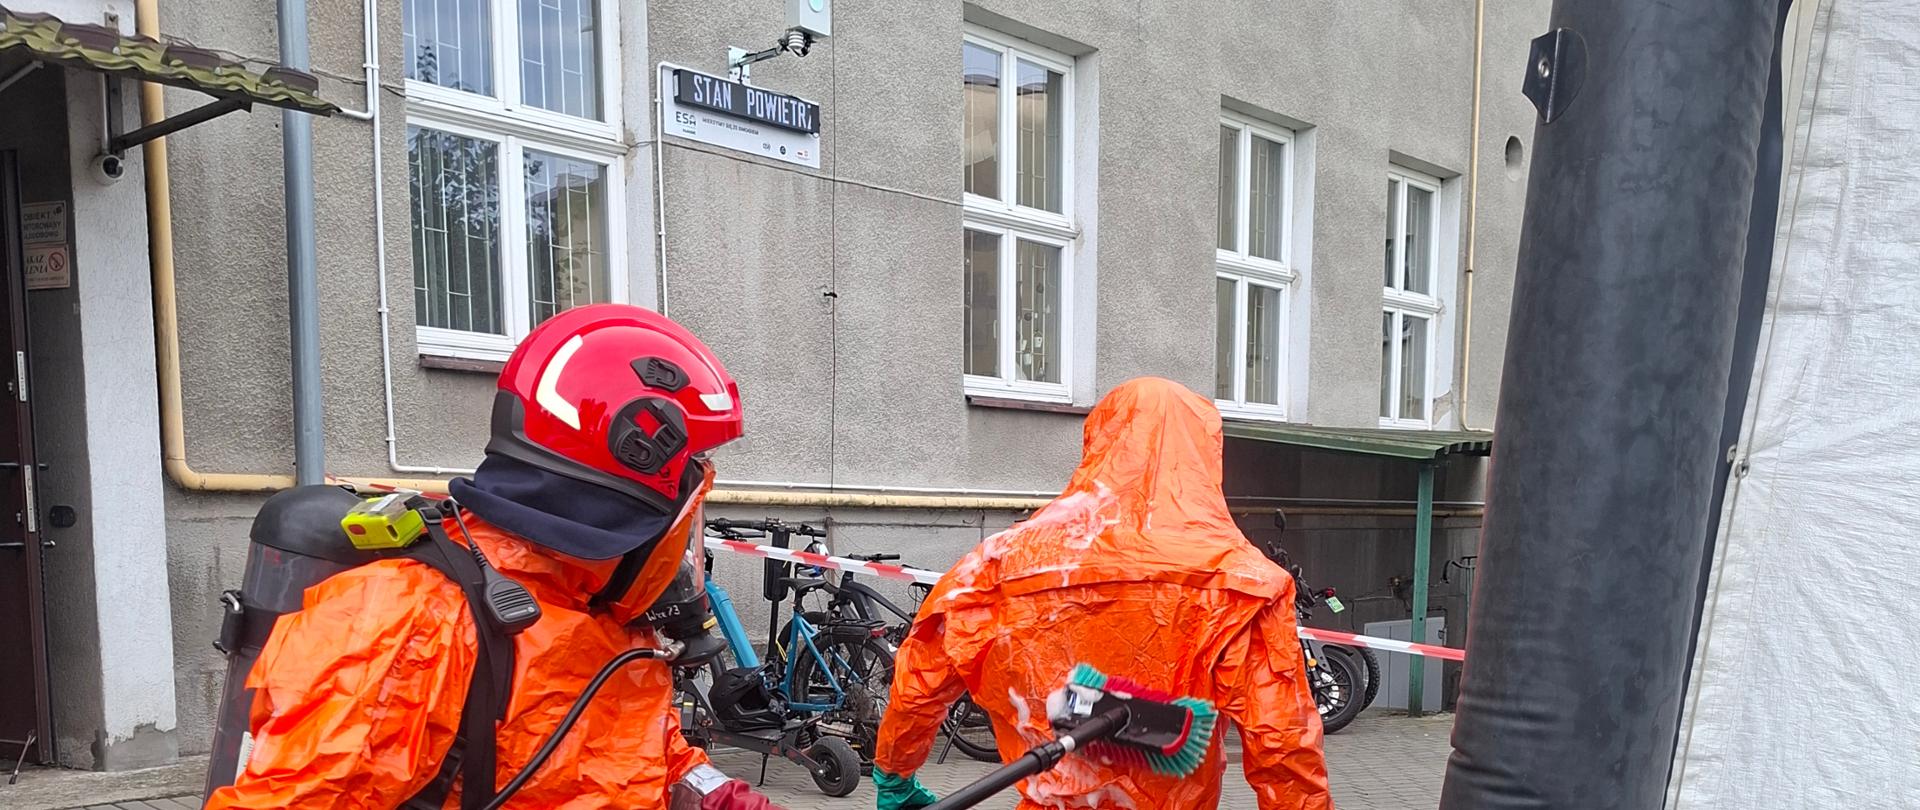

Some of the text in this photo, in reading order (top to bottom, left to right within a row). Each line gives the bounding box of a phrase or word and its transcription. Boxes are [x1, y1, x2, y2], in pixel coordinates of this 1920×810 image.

[693, 74, 732, 110] STAN
[675, 111, 697, 126] ESA
[26, 255, 44, 265] AKAZ
[667, 604, 680, 616] 73
